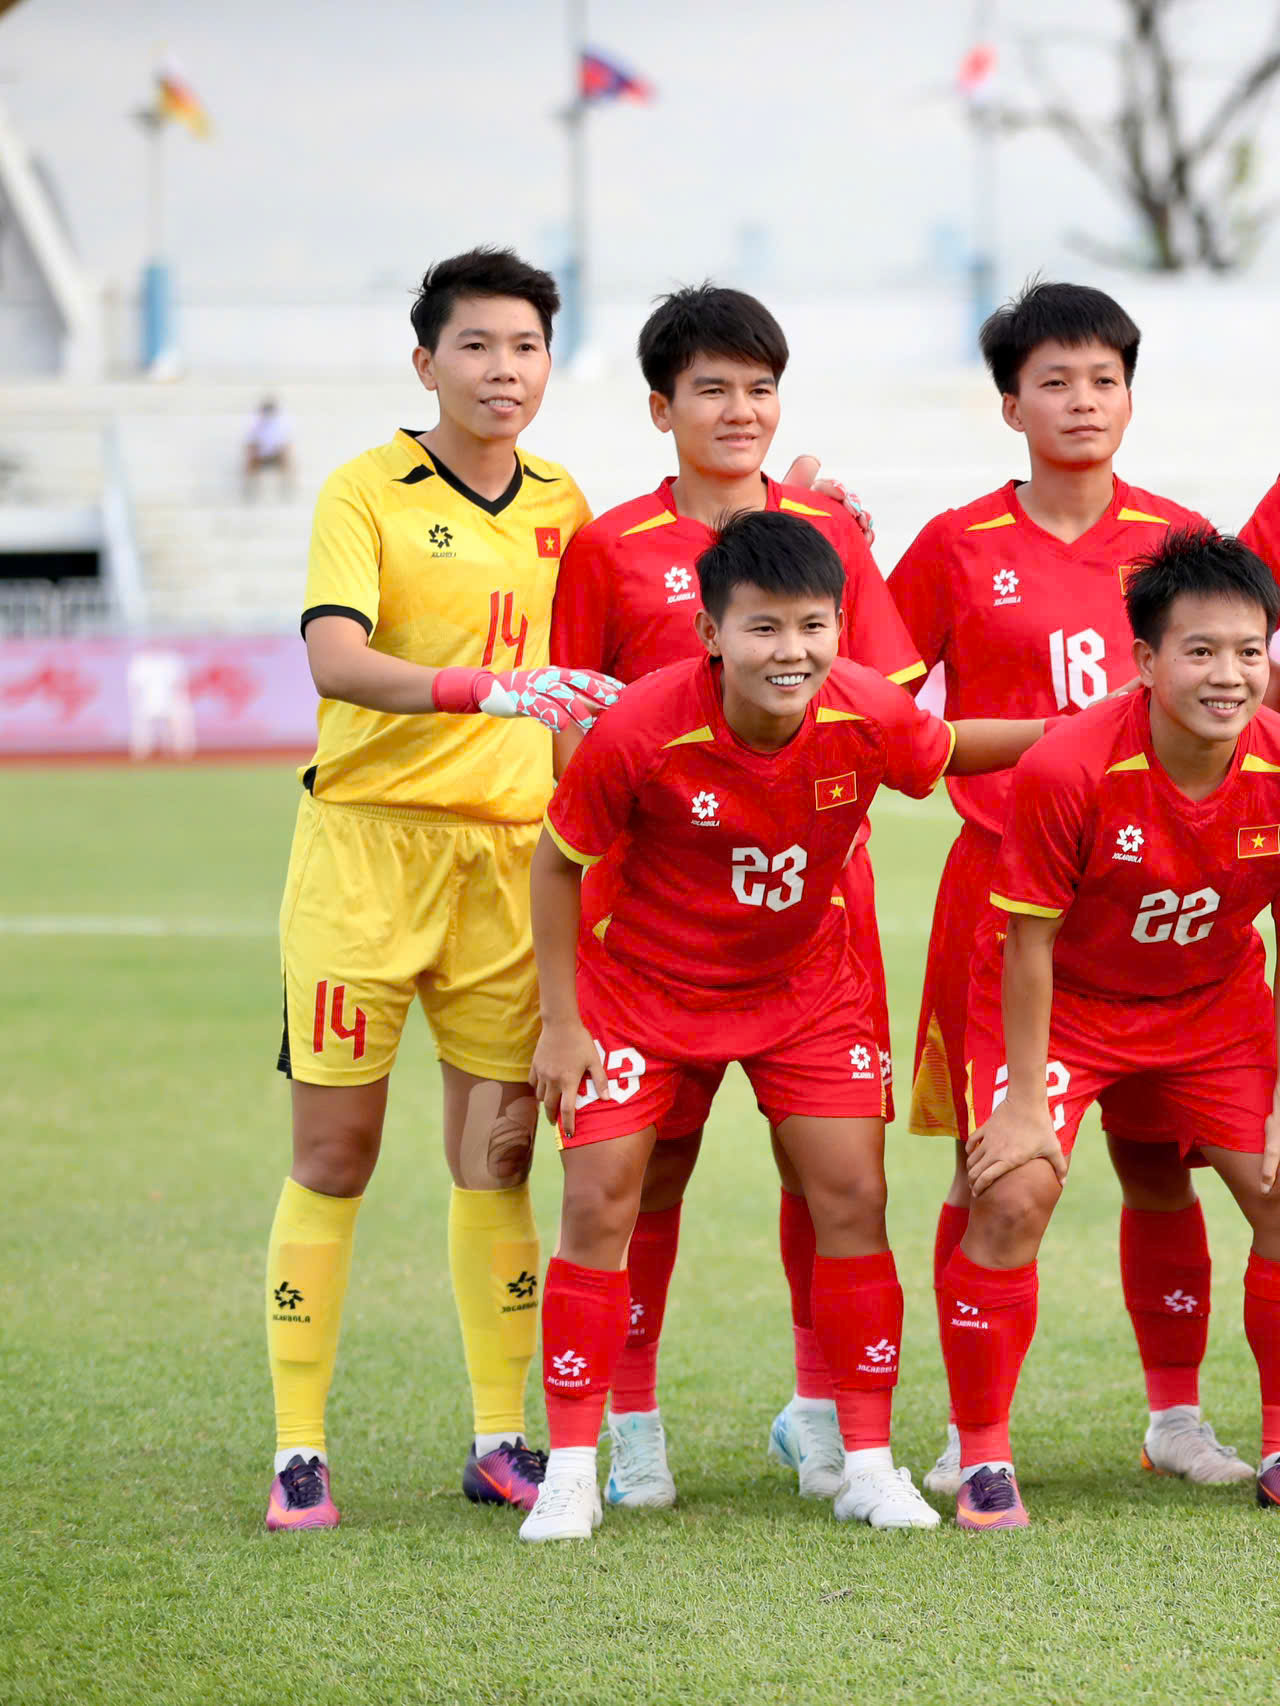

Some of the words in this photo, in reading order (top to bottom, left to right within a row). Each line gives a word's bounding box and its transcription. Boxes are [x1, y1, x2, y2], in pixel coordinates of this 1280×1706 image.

[482, 591, 528, 668] 14
[1048, 628, 1107, 711] 18
[731, 843, 808, 912] 23
[1131, 887, 1220, 946] 22
[313, 980, 367, 1061] 14
